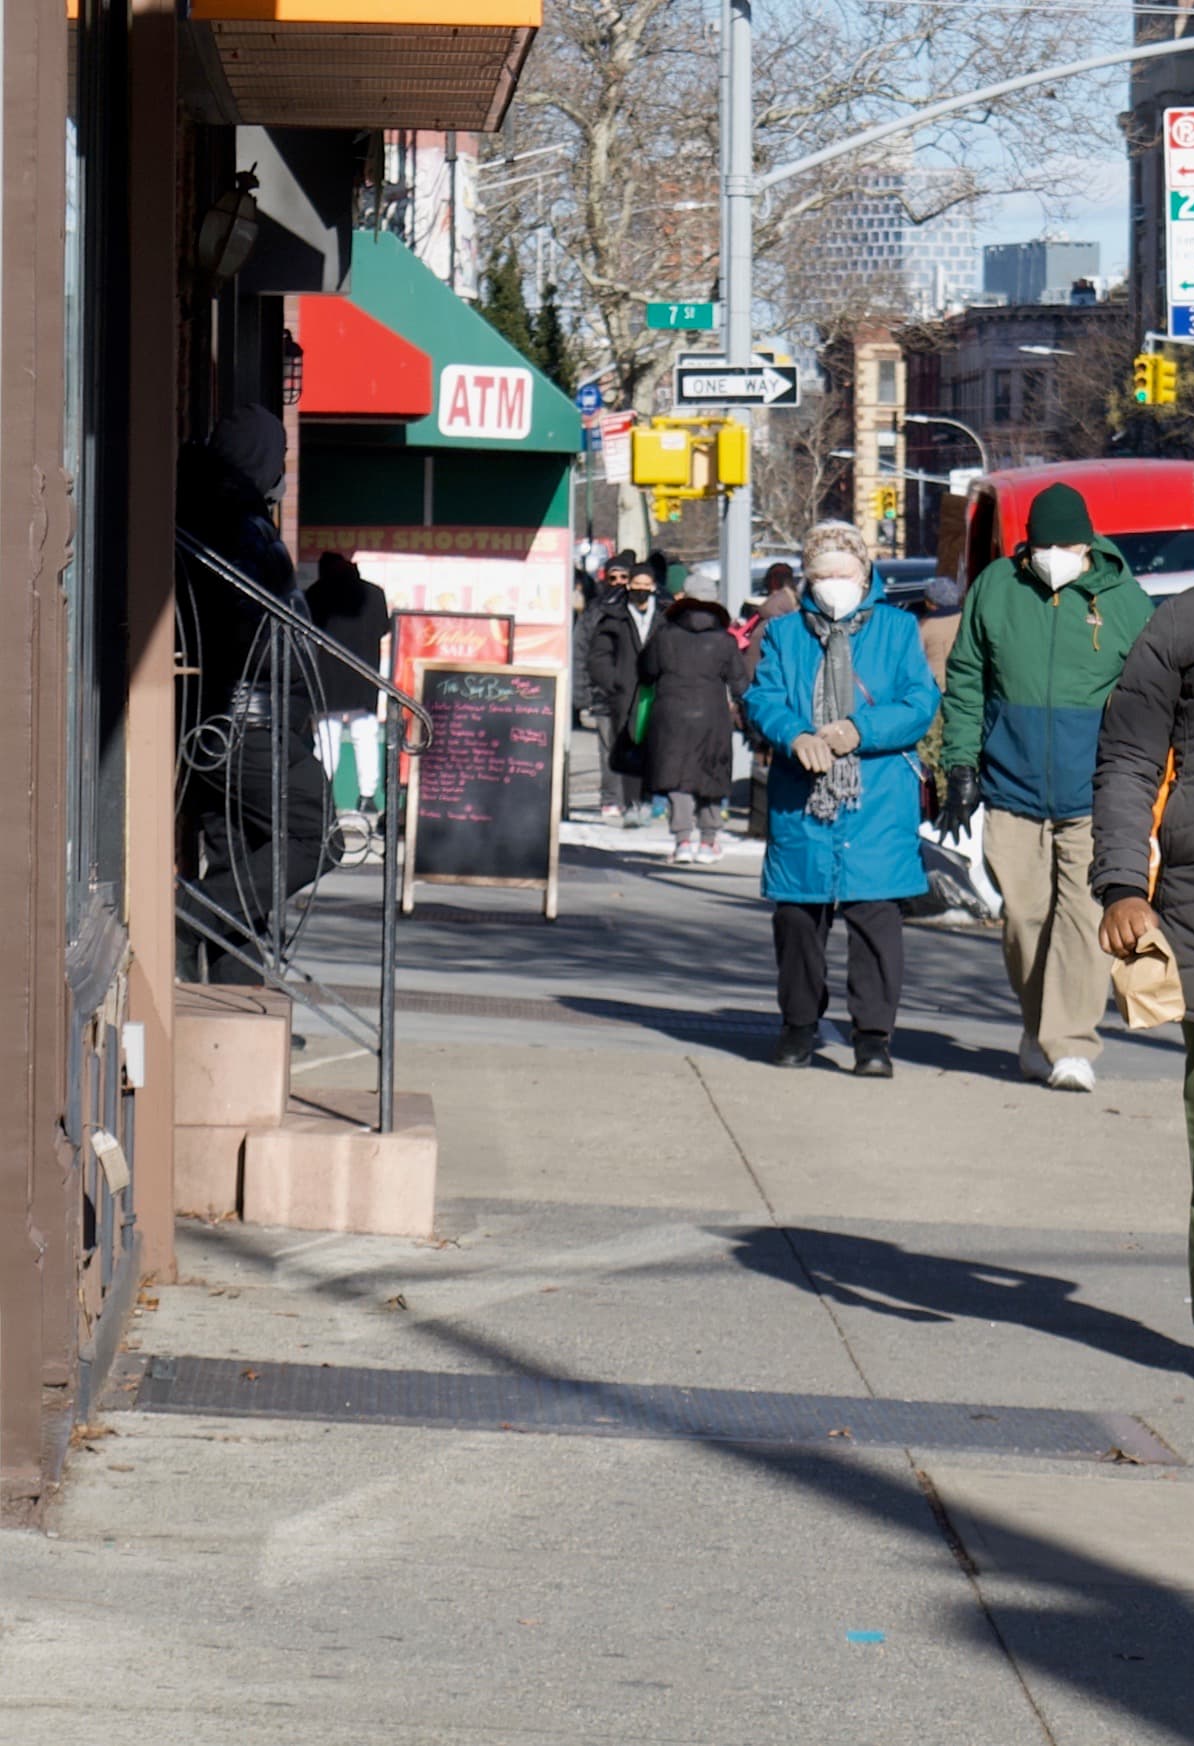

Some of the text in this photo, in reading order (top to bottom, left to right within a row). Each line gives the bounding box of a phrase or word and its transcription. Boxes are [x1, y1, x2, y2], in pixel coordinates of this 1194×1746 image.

[668, 305, 678, 325] 7
[693, 378, 779, 394] ONE WAY
[446, 374, 526, 430] ATM
[301, 531, 559, 551] FRUIT SMOOTHIES
